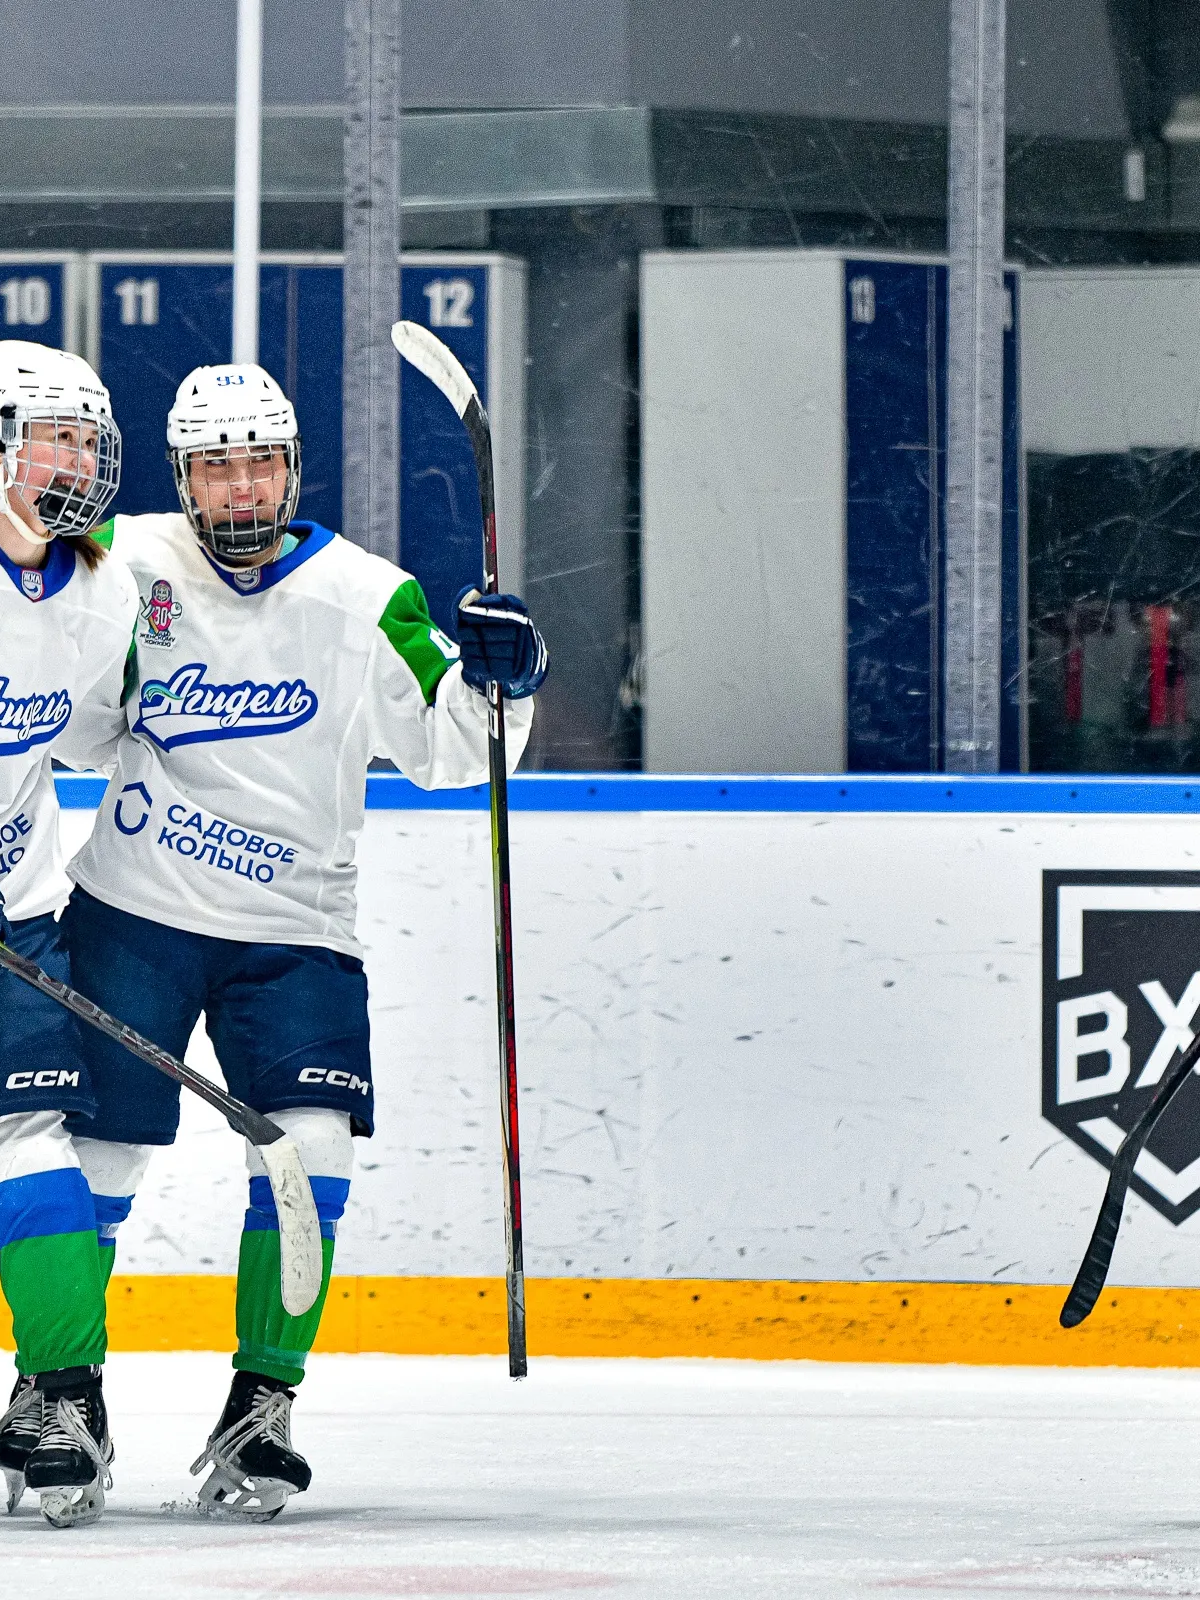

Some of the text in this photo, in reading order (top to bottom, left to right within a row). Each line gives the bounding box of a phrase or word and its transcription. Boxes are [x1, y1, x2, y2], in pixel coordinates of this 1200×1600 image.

[113, 277, 159, 325] 11
[423, 279, 474, 327] 12
[154, 606, 168, 627] 30
[141, 665, 315, 729] Агидель
[157, 826, 275, 884] КОЛЬЦО
[166, 803, 299, 864] САДОВОЕ
[5, 1069, 80, 1090] CCM
[297, 1067, 370, 1096] CCM
